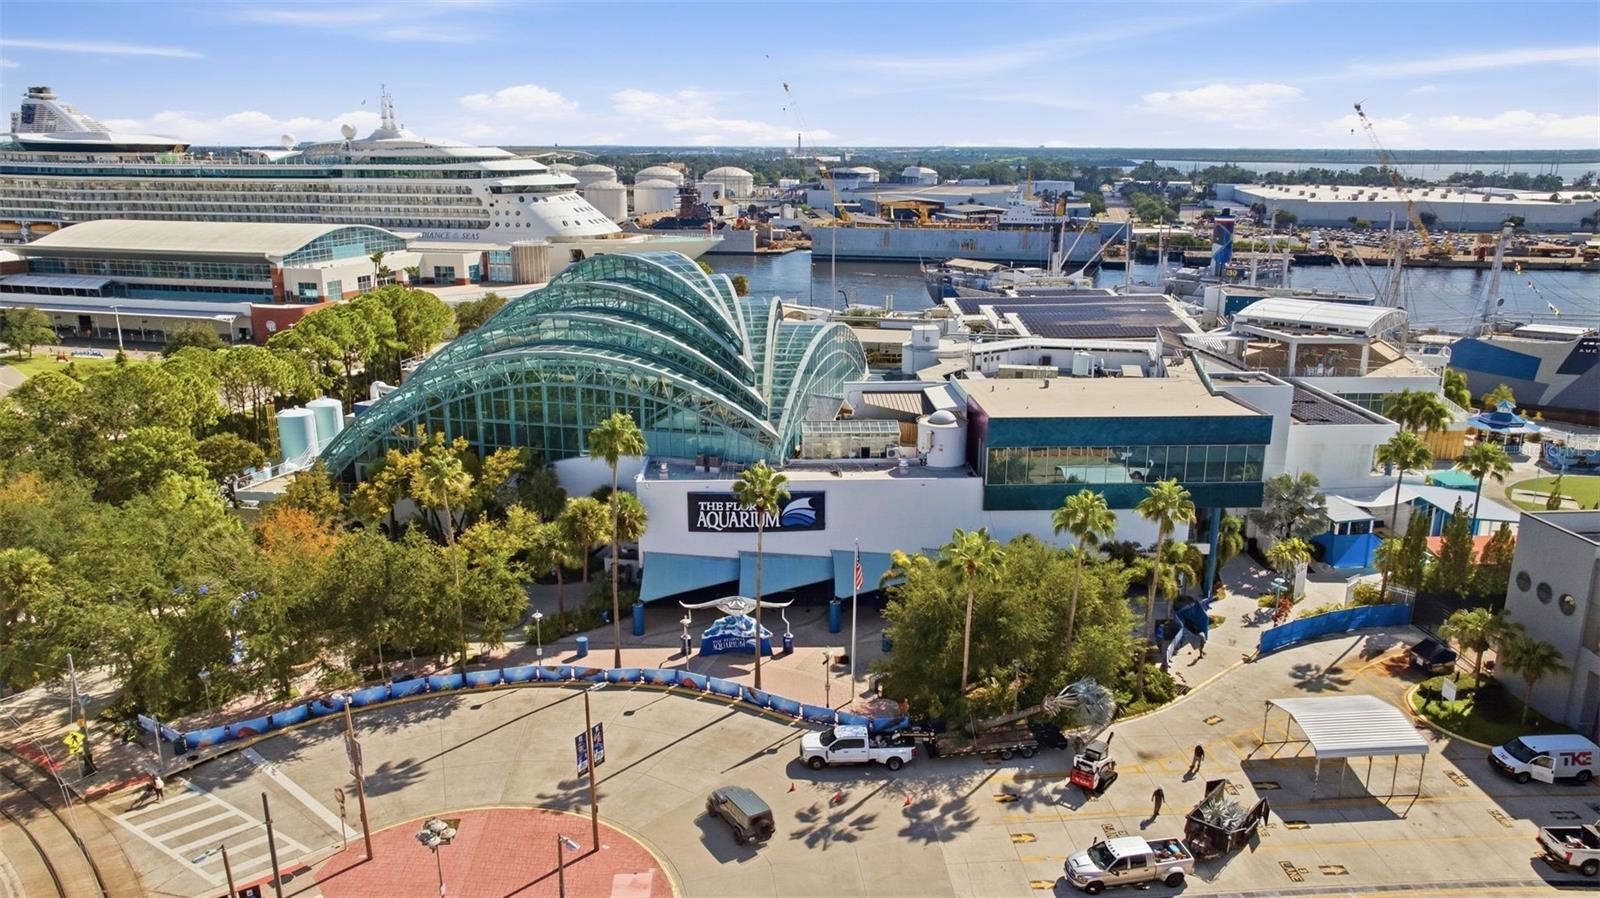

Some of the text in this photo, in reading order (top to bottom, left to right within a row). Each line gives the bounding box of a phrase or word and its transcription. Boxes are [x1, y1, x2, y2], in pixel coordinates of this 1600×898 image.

[422, 231, 450, 240] DIANCE
[462, 232, 480, 240] SEAS
[698, 502, 723, 511] THE
[697, 511, 781, 531] AQUARIUM
[1560, 752, 1592, 766] TKE
